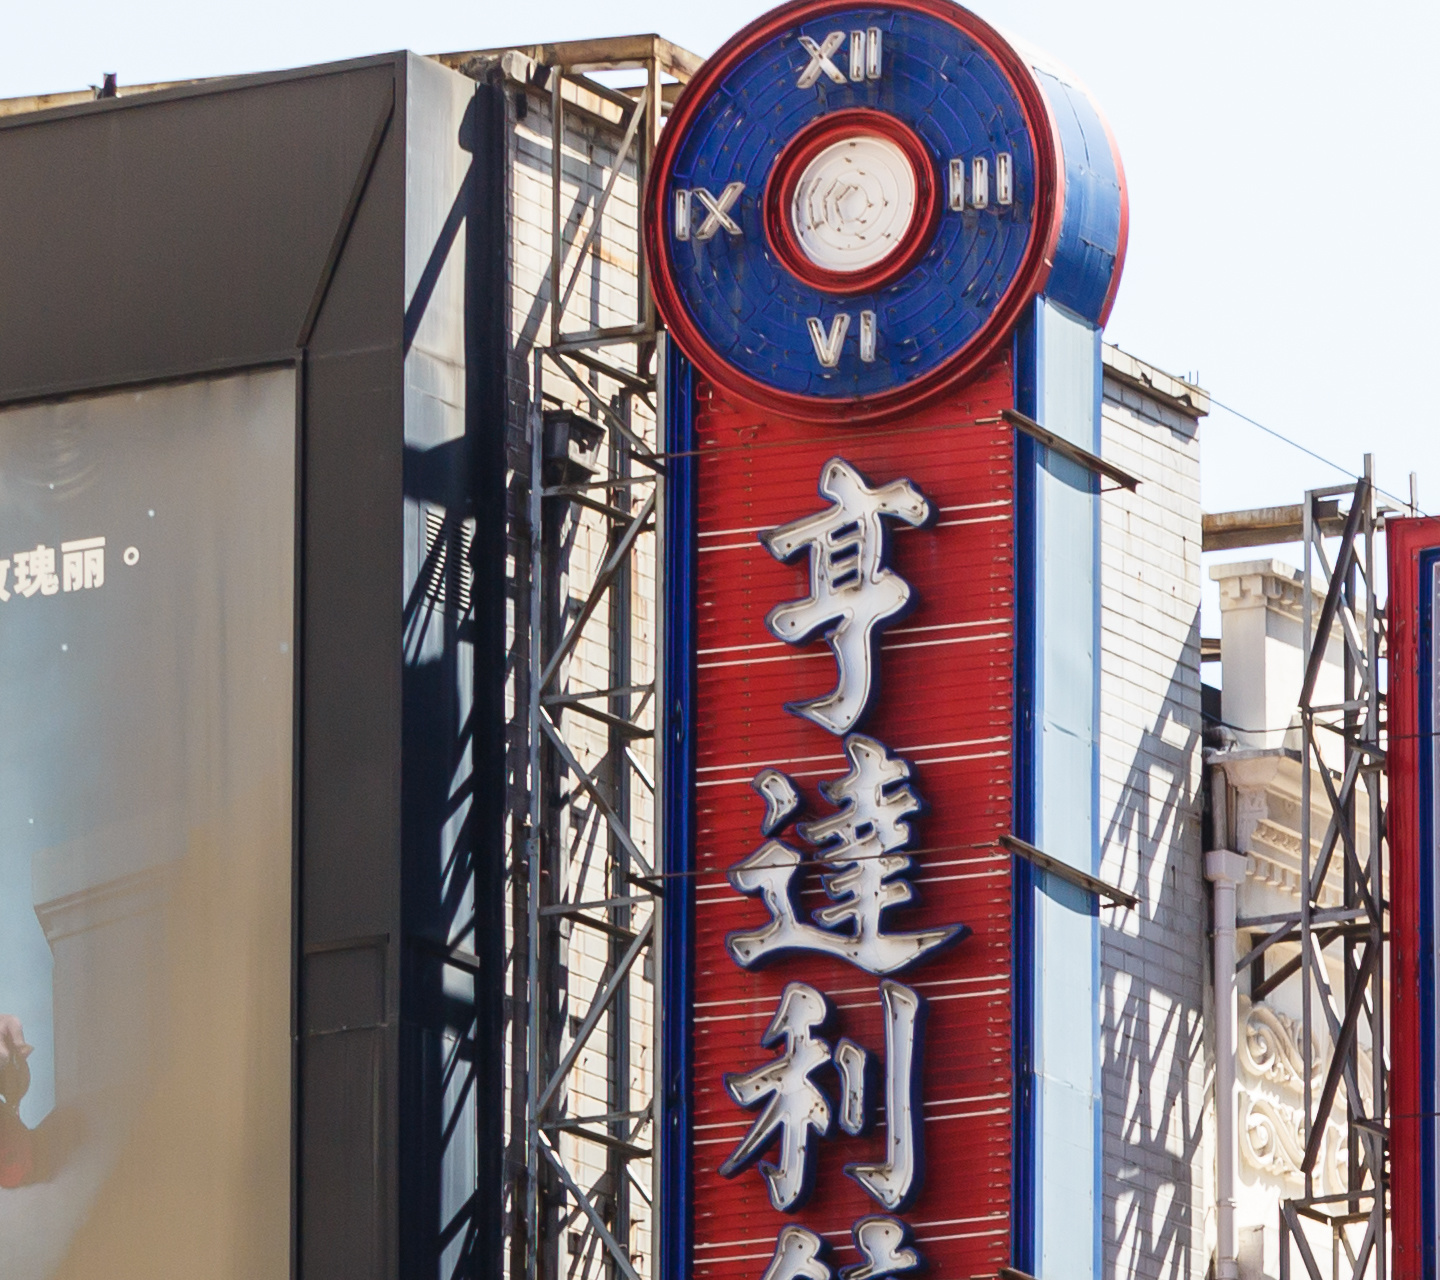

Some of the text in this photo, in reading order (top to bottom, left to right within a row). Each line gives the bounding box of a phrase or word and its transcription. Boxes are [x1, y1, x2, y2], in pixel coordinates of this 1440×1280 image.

[797, 28, 883, 89] XII
[948, 153, 1013, 210] III
[676, 182, 745, 241] IX
[806, 312, 878, 368] VI
[0, 537, 139, 602] 瑰丽。
